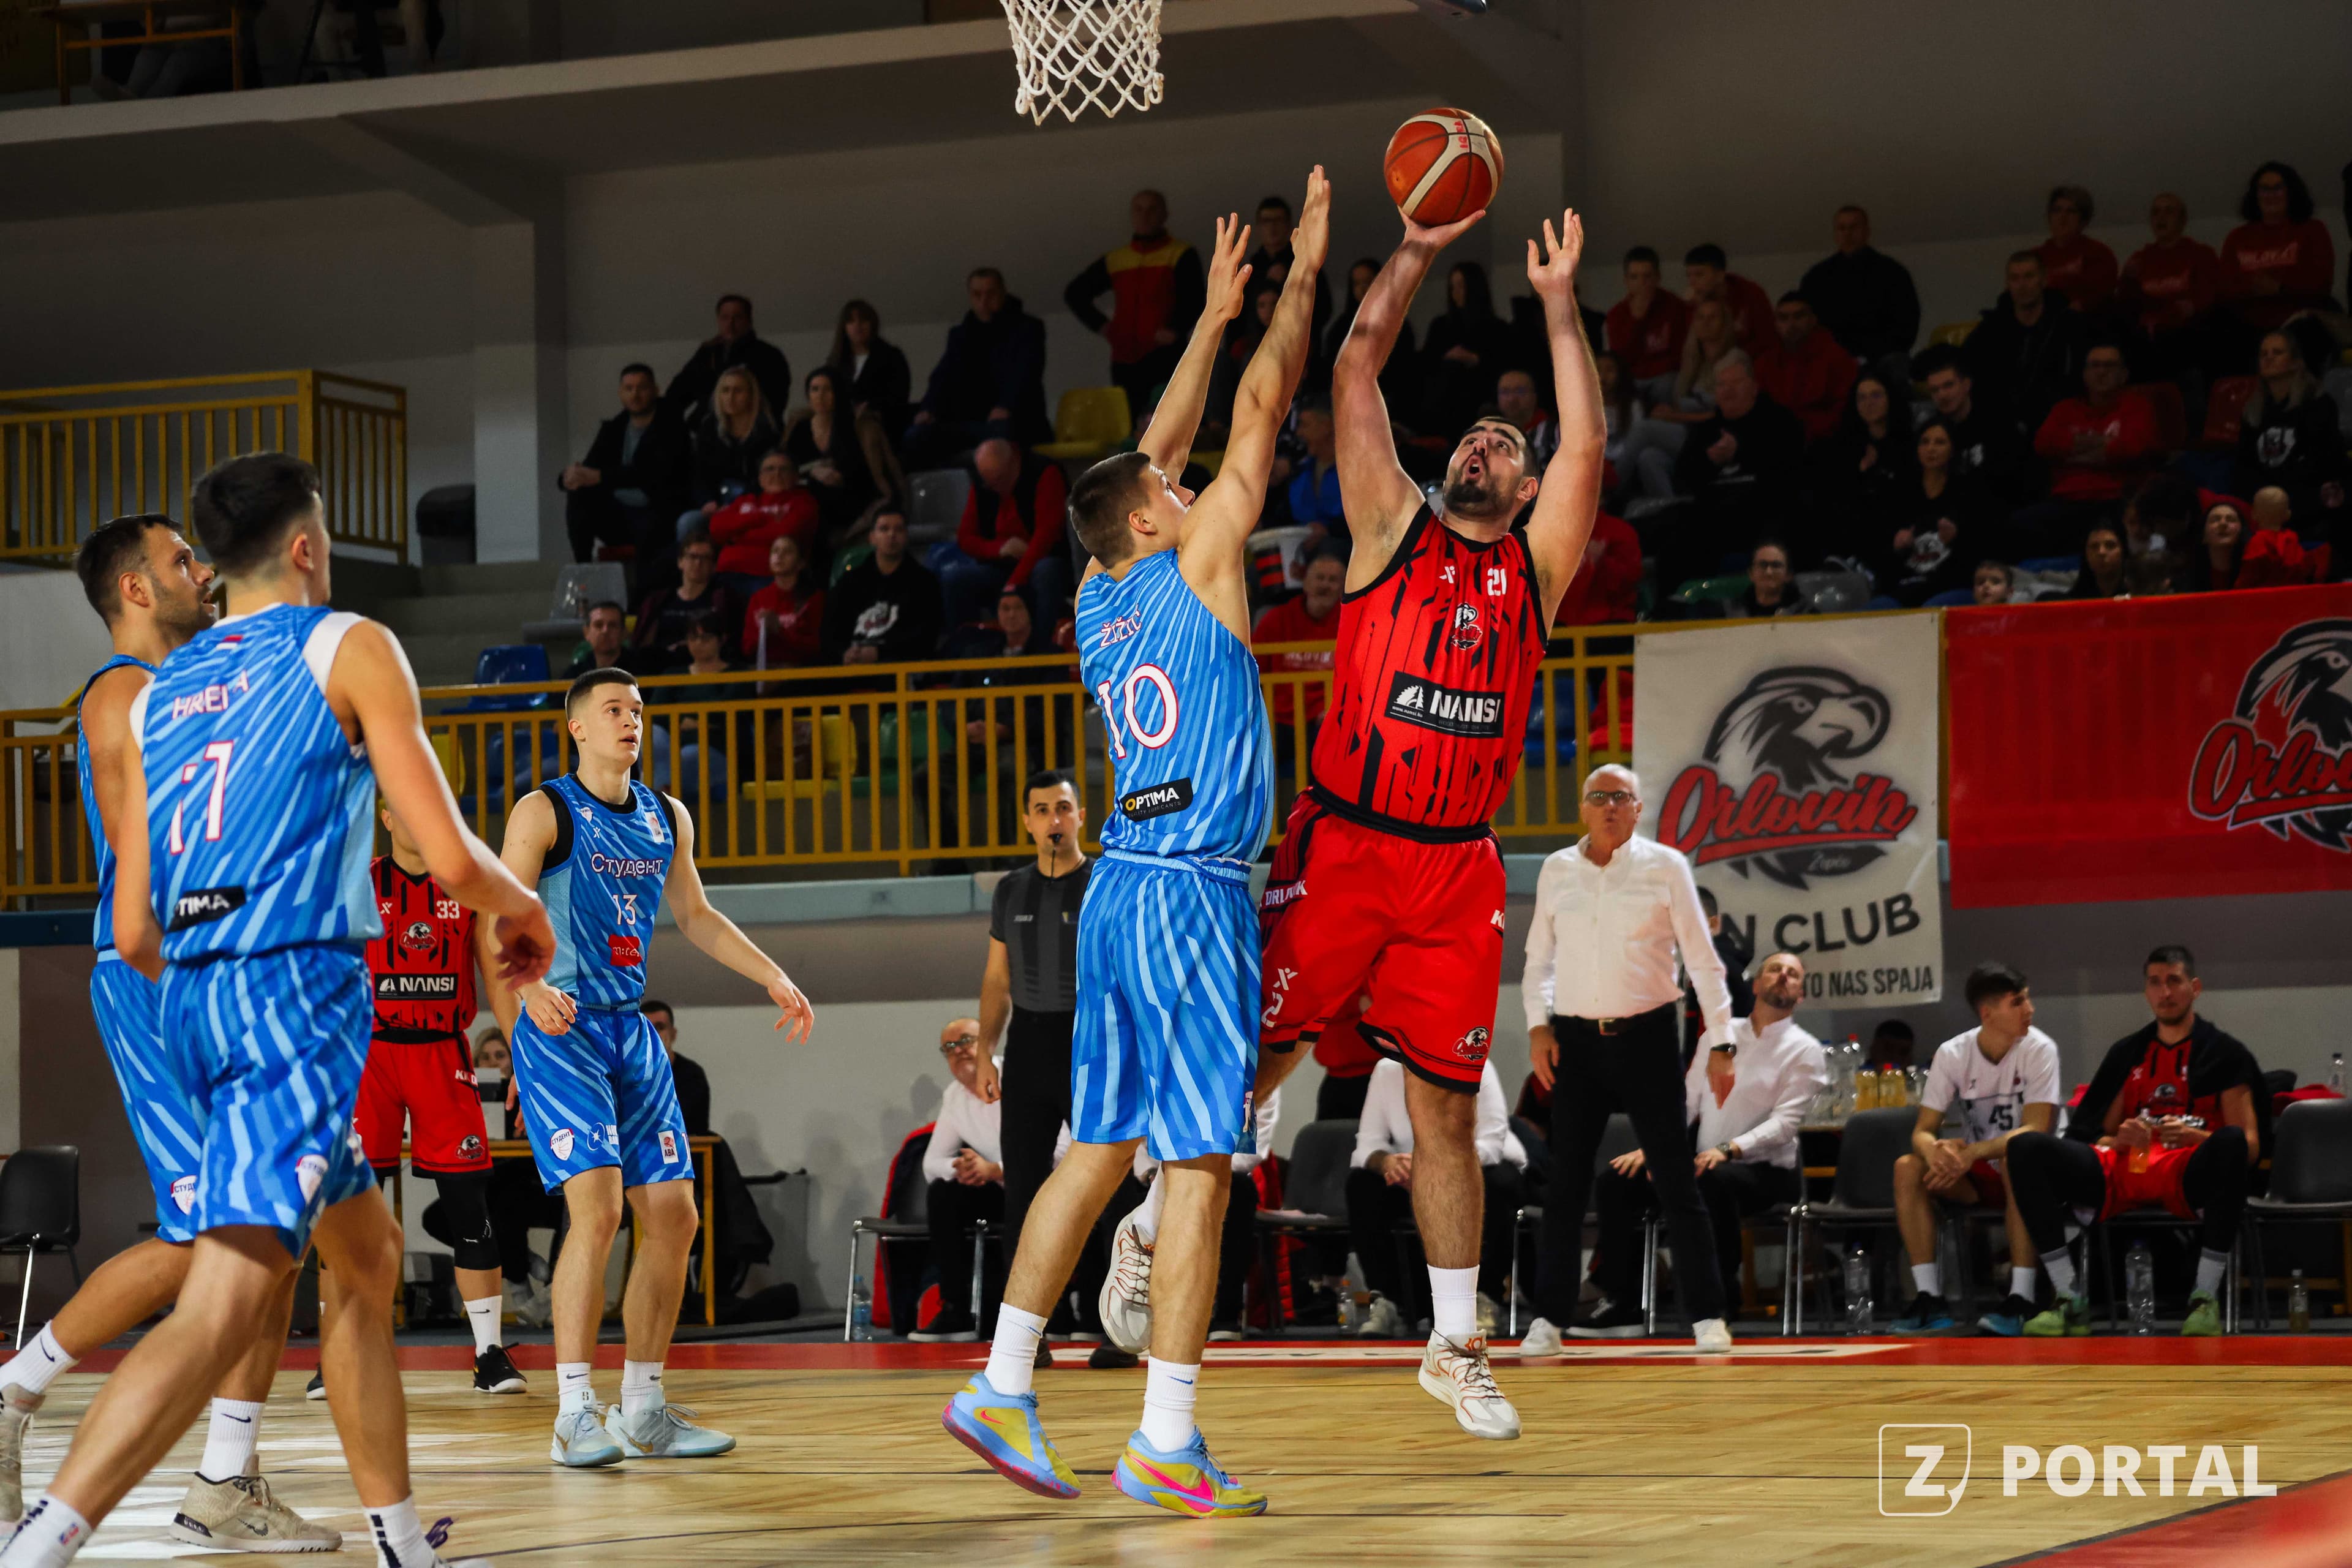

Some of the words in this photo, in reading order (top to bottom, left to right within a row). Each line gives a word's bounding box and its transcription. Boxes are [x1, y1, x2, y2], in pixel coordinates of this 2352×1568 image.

[1487, 568, 1507, 596] 21
[1097, 663, 1179, 760] 10
[1430, 690, 1501, 723] NANSI
[2190, 721, 2352, 821] Orlo
[1125, 787, 1180, 811] OPTIMA
[1657, 766, 1918, 855] Orlovik
[591, 852, 663, 878] Студент
[176, 894, 230, 917] TIMA
[436, 900, 460, 919] 33
[612, 894, 637, 925] 13
[1773, 892, 1921, 954] CLUB
[399, 977, 454, 992] NANSI
[1830, 970, 1868, 997] NAS
[1874, 965, 1934, 995] SPAJA
[1989, 1104, 2013, 1131] 45
[551, 1131, 571, 1145] СТУДЕНТ
[175, 1183, 195, 1193] СТУД
